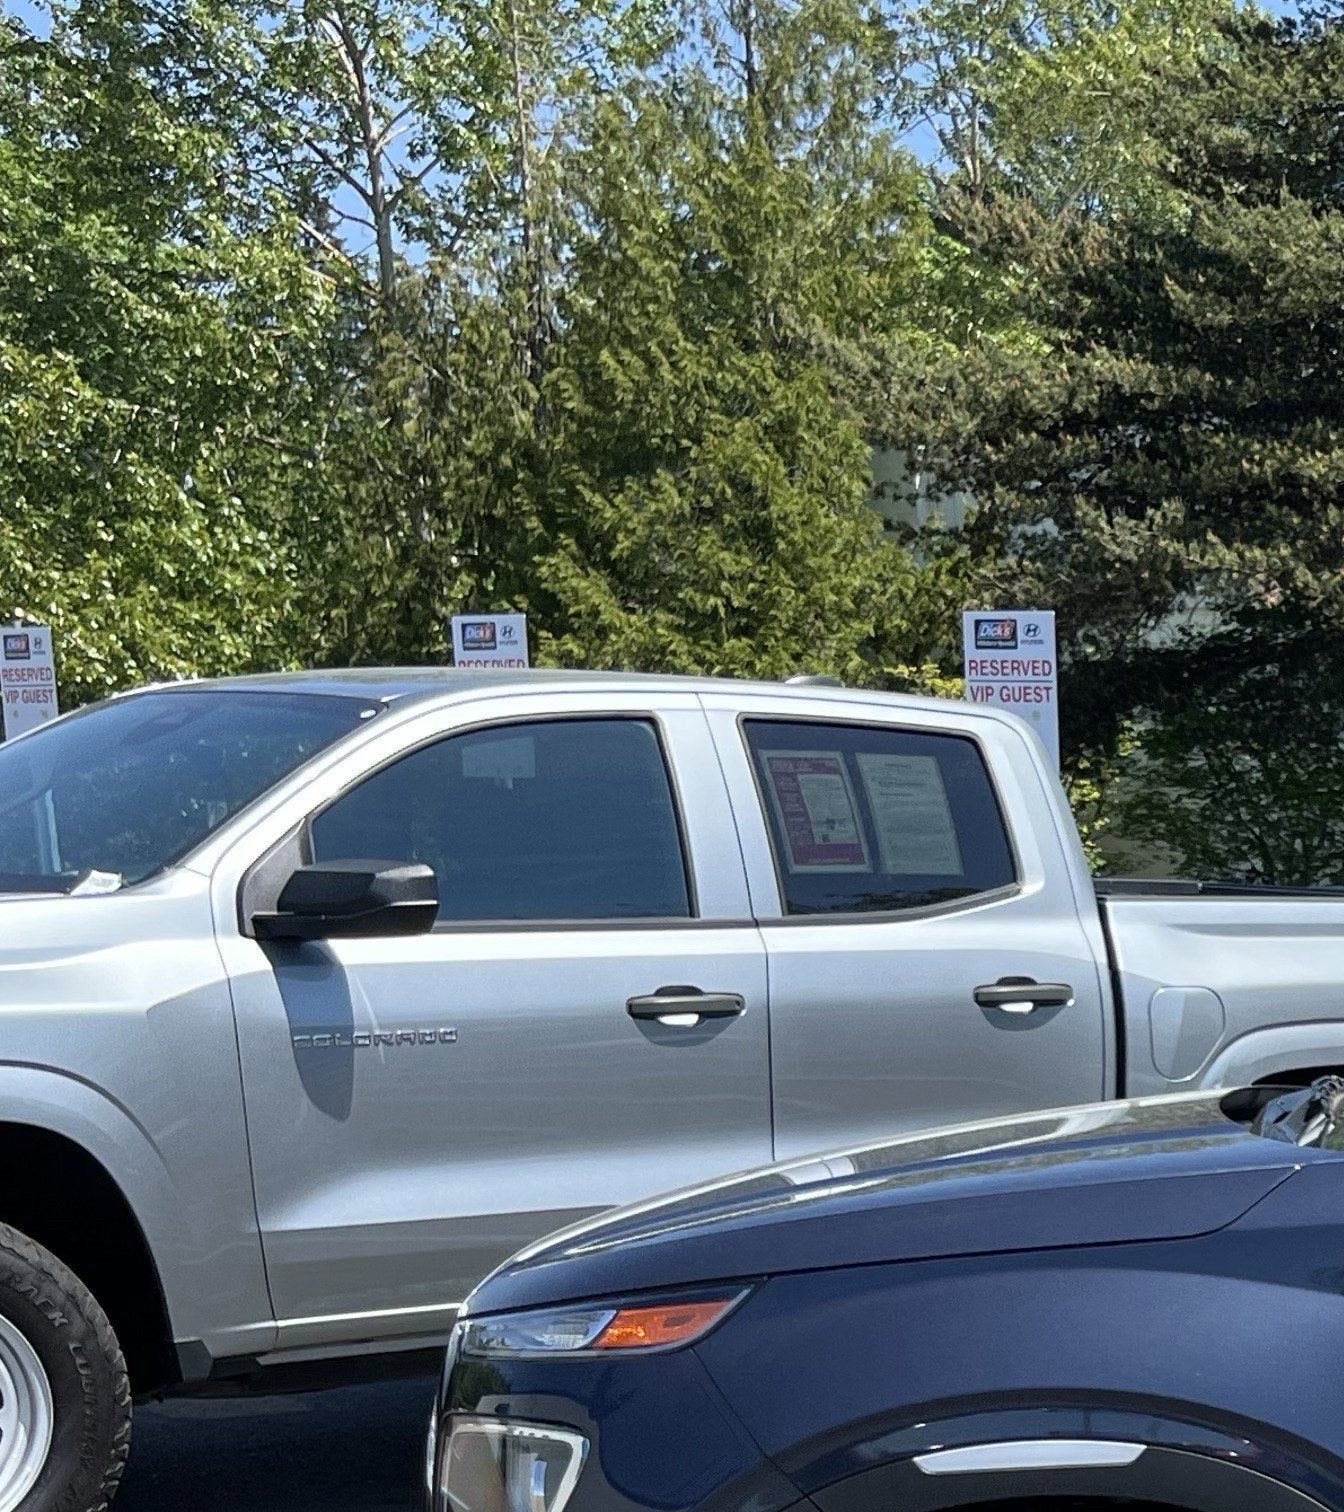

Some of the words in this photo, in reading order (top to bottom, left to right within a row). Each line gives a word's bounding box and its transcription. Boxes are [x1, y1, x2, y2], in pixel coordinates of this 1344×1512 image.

[1, 667, 53, 682] RESERVED
[968, 659, 1052, 677] RESERVED
[4, 689, 19, 704] VIP
[22, 688, 54, 704] GUEST
[970, 685, 995, 702] VIP
[999, 685, 1053, 703] GUEST
[293, 1027, 458, 1047] COLORADO
